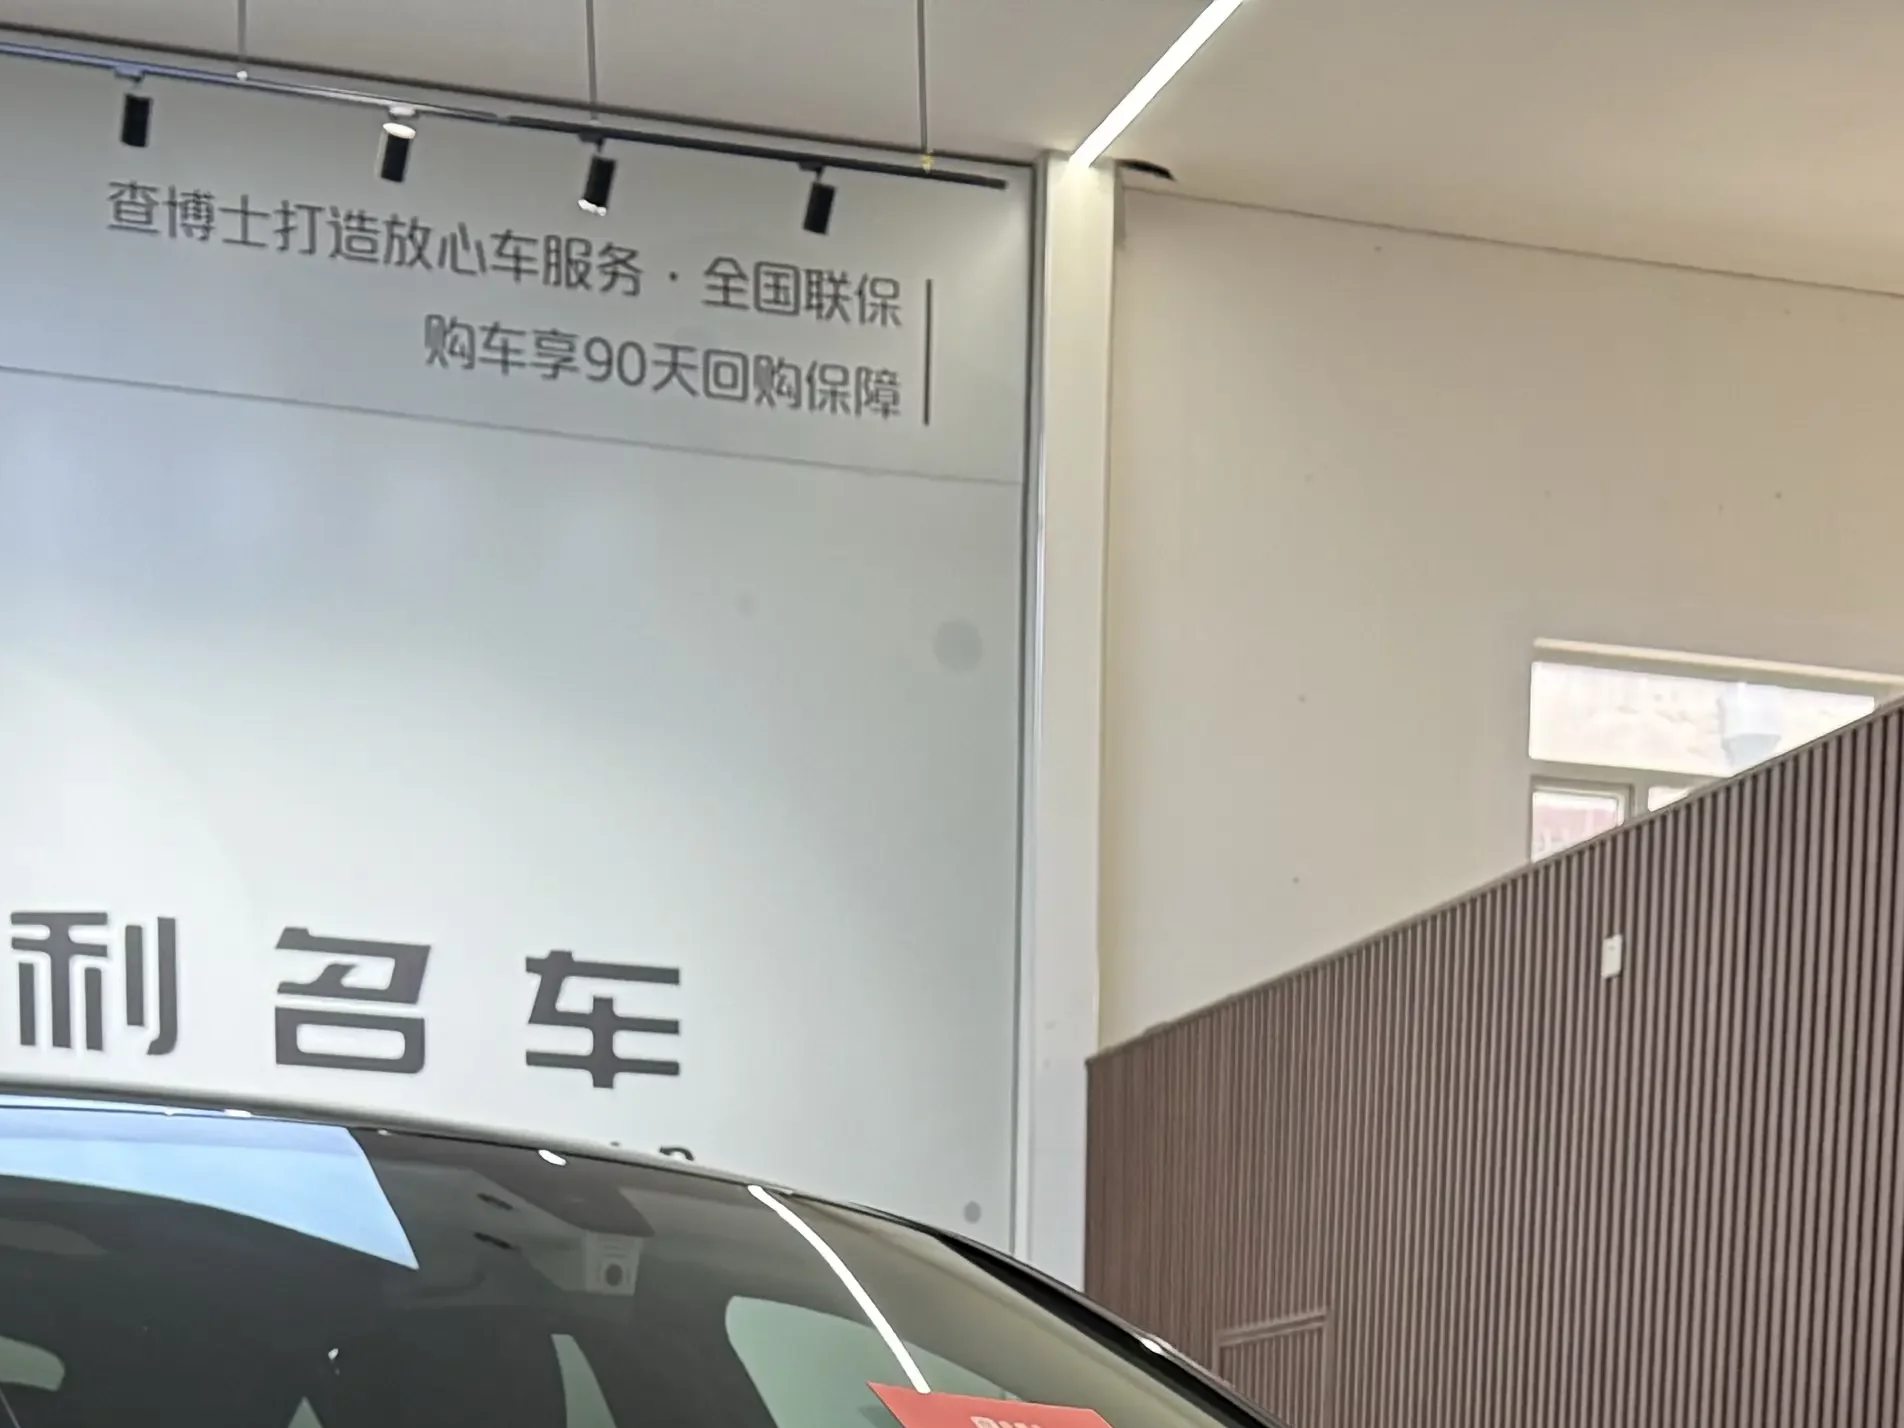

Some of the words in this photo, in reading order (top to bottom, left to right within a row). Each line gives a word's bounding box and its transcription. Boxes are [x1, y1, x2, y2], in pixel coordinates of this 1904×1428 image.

[424, 314, 902, 420] 购车享90天回购保障
